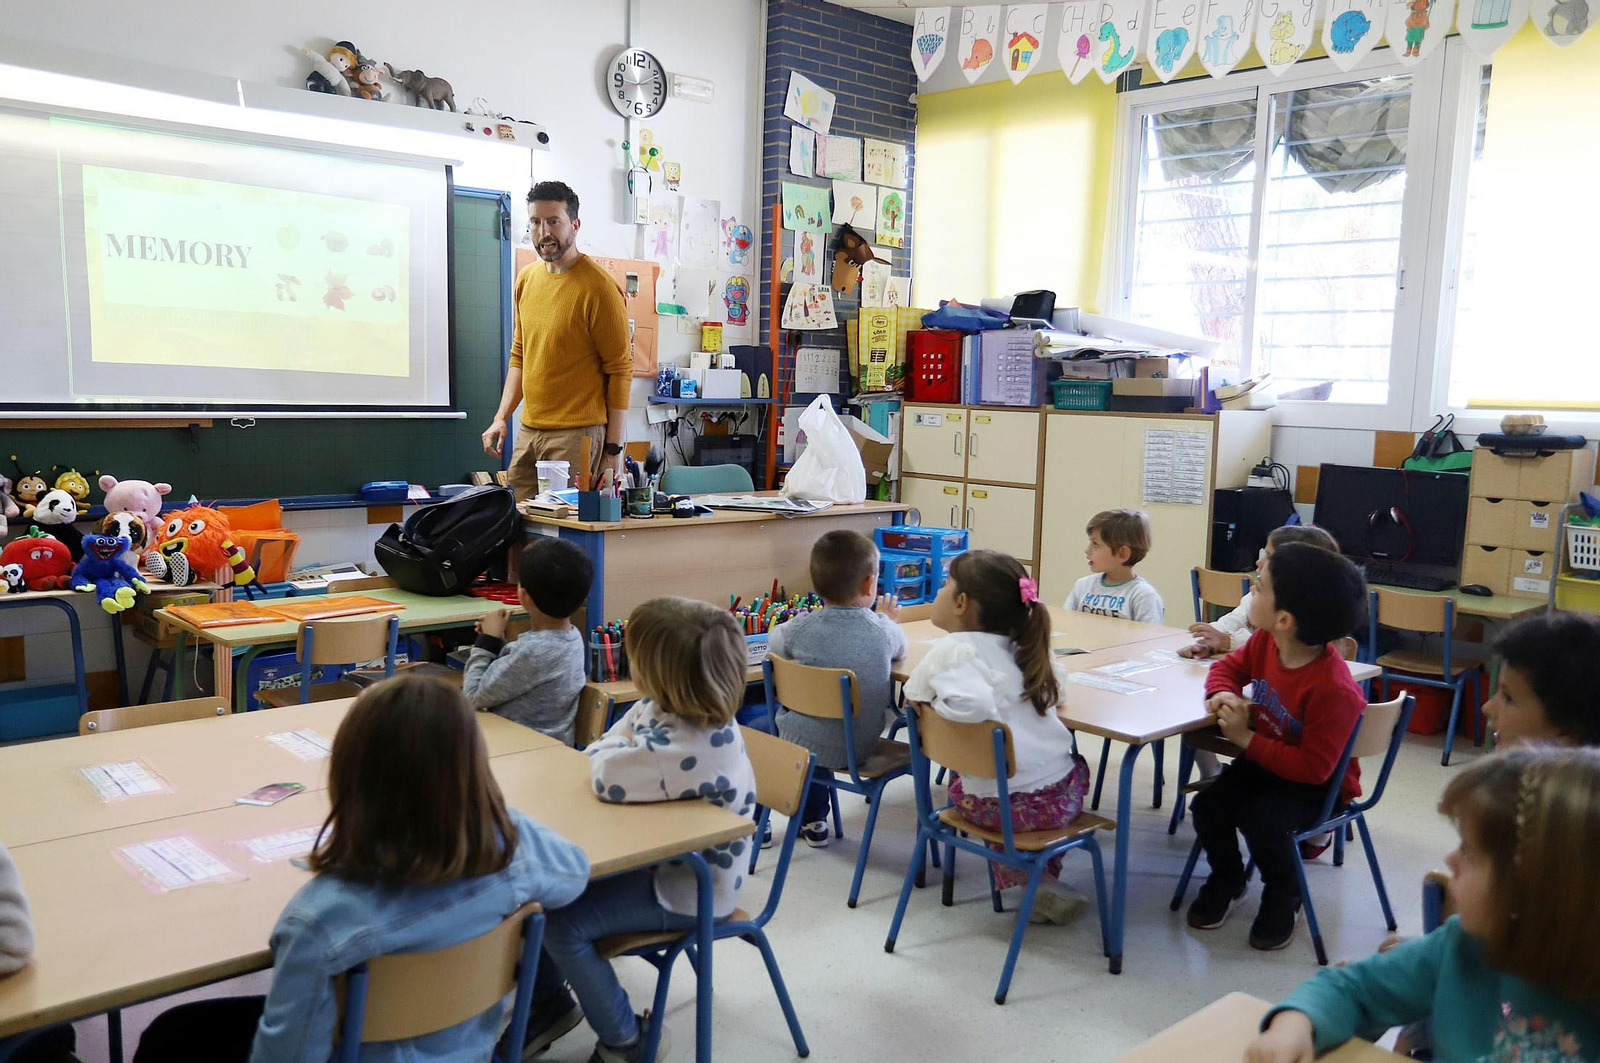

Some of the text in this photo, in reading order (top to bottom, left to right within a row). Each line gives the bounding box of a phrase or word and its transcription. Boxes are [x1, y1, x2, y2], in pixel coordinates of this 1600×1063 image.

[962, 9, 995, 35] B b
[1006, 8, 1018, 35] C
[1061, 5, 1086, 33] CH
[1100, 3, 1139, 32] D d
[1153, 0, 1196, 29] E e
[915, 11, 945, 35] A a
[618, 63, 625, 72] 10
[626, 56, 631, 65] 11
[633, 52, 645, 69] 12
[614, 73, 623, 87] 9
[653, 70, 659, 79] 2
[619, 91, 624, 99] 8
[654, 81, 662, 96] 3
[626, 100, 631, 108] 7
[634, 102, 643, 115] 6
[646, 104, 651, 112] 5
[652, 97, 658, 106] 4
[105, 232, 252, 269] MEMORY
[1083, 592, 1126, 611] MOTOR
